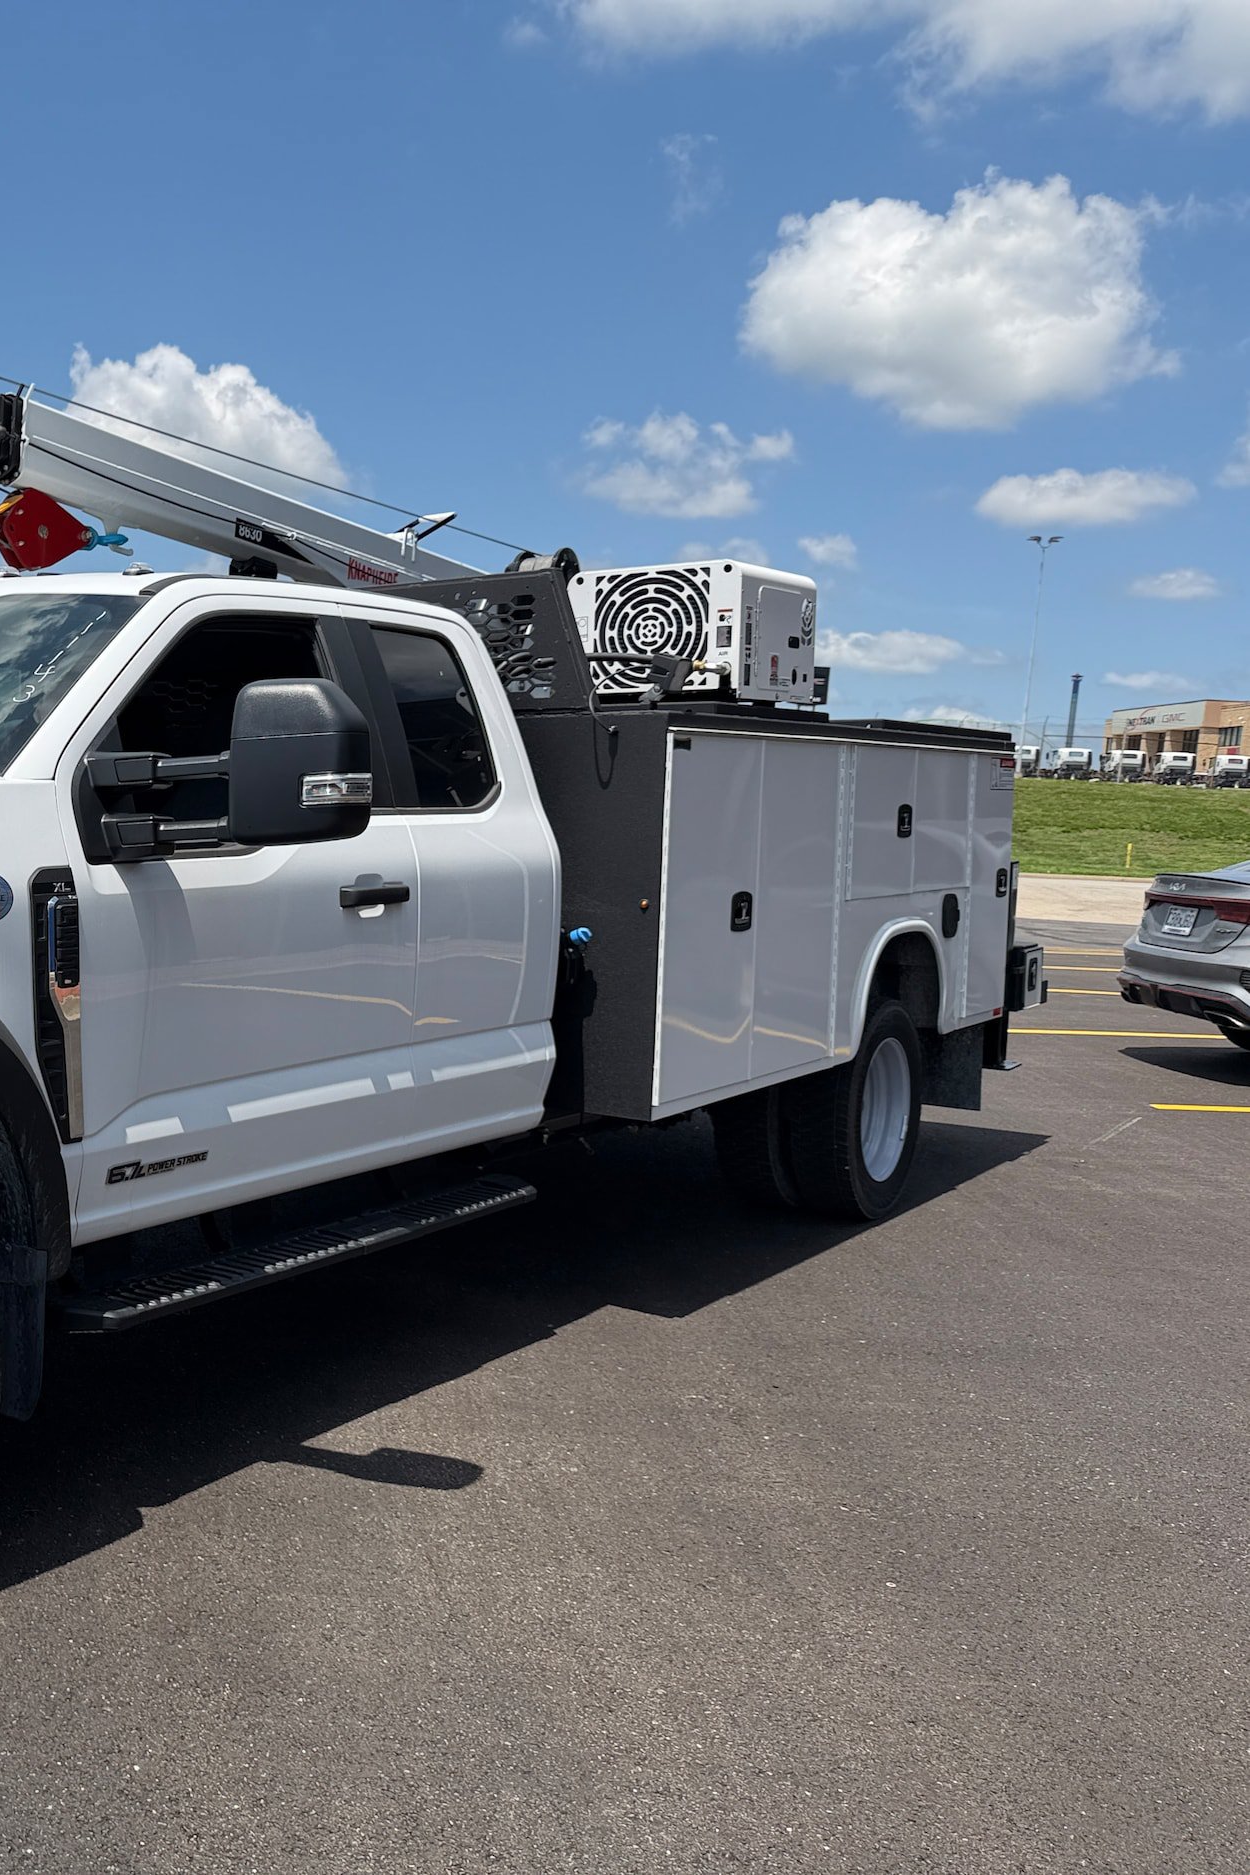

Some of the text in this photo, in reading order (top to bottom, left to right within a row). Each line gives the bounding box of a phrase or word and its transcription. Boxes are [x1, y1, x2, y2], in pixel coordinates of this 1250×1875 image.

[239, 525, 263, 543] 8630
[1162, 712, 1186, 723] GMC
[52, 882, 71, 893] XL
[147, 1158, 176, 1173] POWER
[176, 1150, 209, 1166] STROKE
